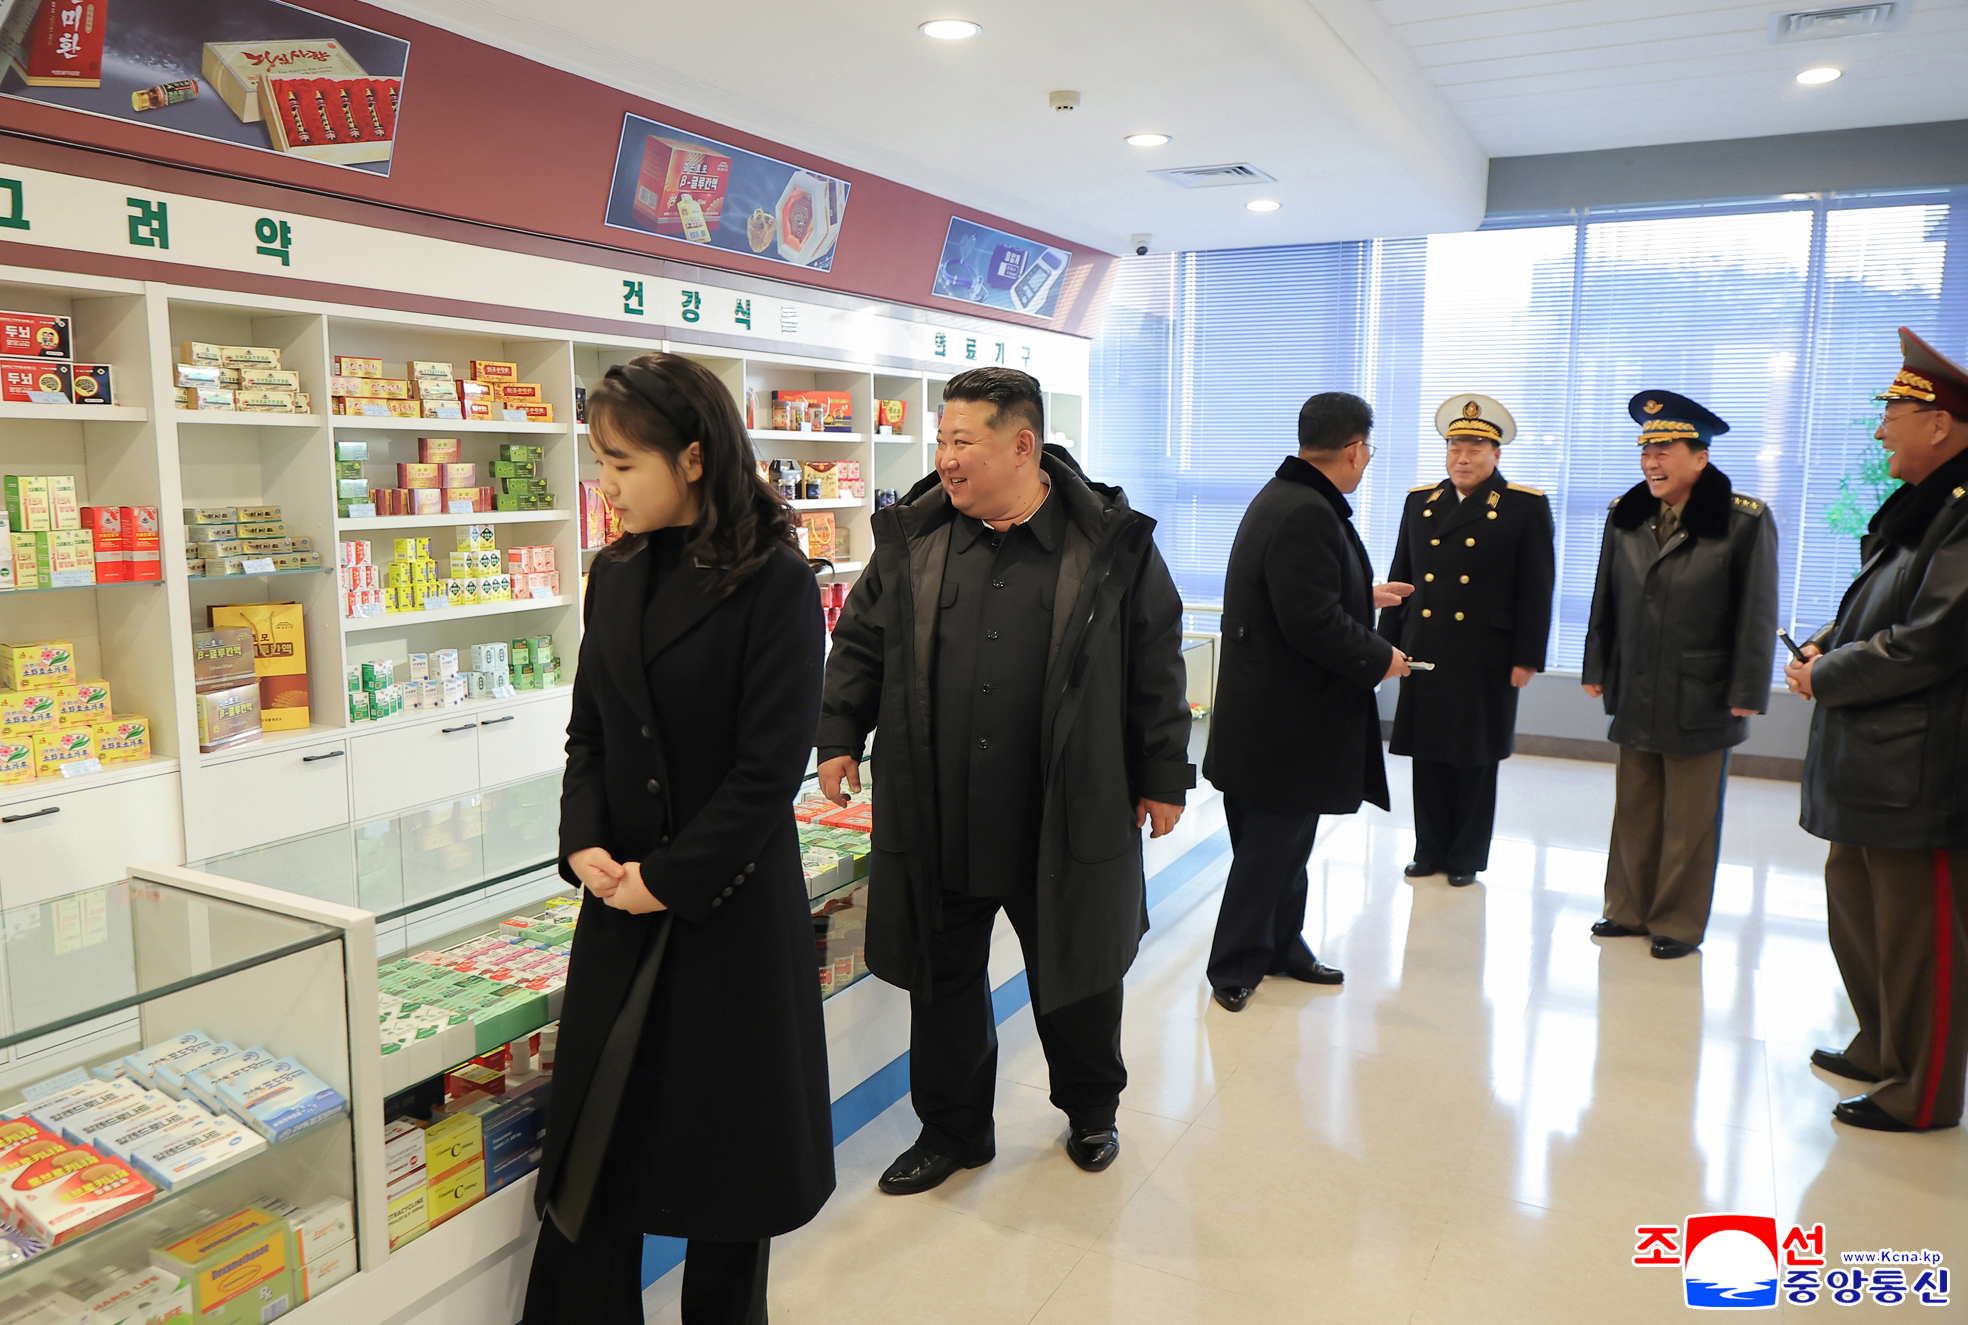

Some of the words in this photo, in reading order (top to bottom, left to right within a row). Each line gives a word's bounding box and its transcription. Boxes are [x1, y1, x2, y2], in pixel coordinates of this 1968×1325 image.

[5, 325, 30, 338] 두뇌
[8, 372, 33, 385] 두뇌
[451, 1142, 462, 1157] C
[454, 1184, 465, 1199] C
